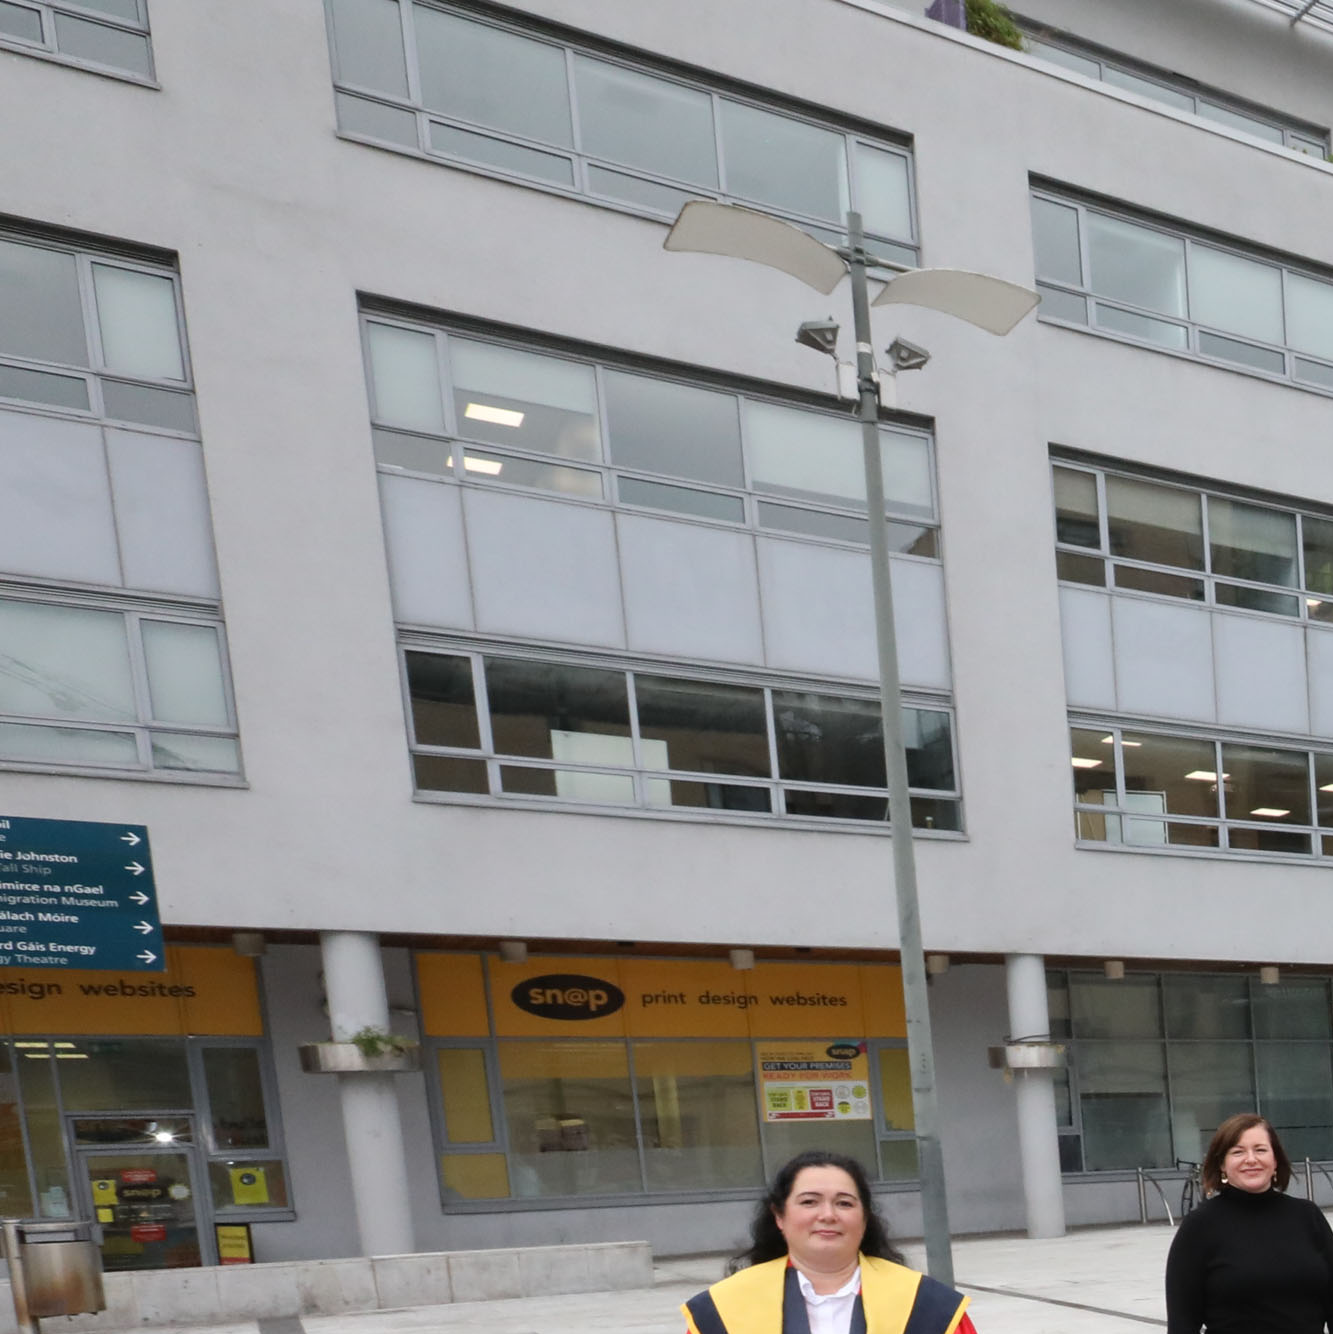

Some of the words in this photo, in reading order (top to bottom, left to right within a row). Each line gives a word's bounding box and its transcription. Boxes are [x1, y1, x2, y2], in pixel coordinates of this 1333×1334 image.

[16, 851, 78, 863] Johnston
[22, 864, 52, 876] Ship
[43, 884, 61, 893] na
[64, 884, 104, 895] nGael
[61, 896, 119, 908] Museum
[38, 912, 79, 923] Móire
[16, 941, 46, 951] Gáis
[49, 943, 96, 955] Energy
[15, 954, 68, 965] Theatre
[79, 979, 197, 998] websites
[528, 985, 608, 1011] sn@p
[641, 991, 687, 1008] print
[698, 990, 758, 1009] design
[769, 992, 847, 1007] websites
[783, 1062, 808, 1070] YOUR
